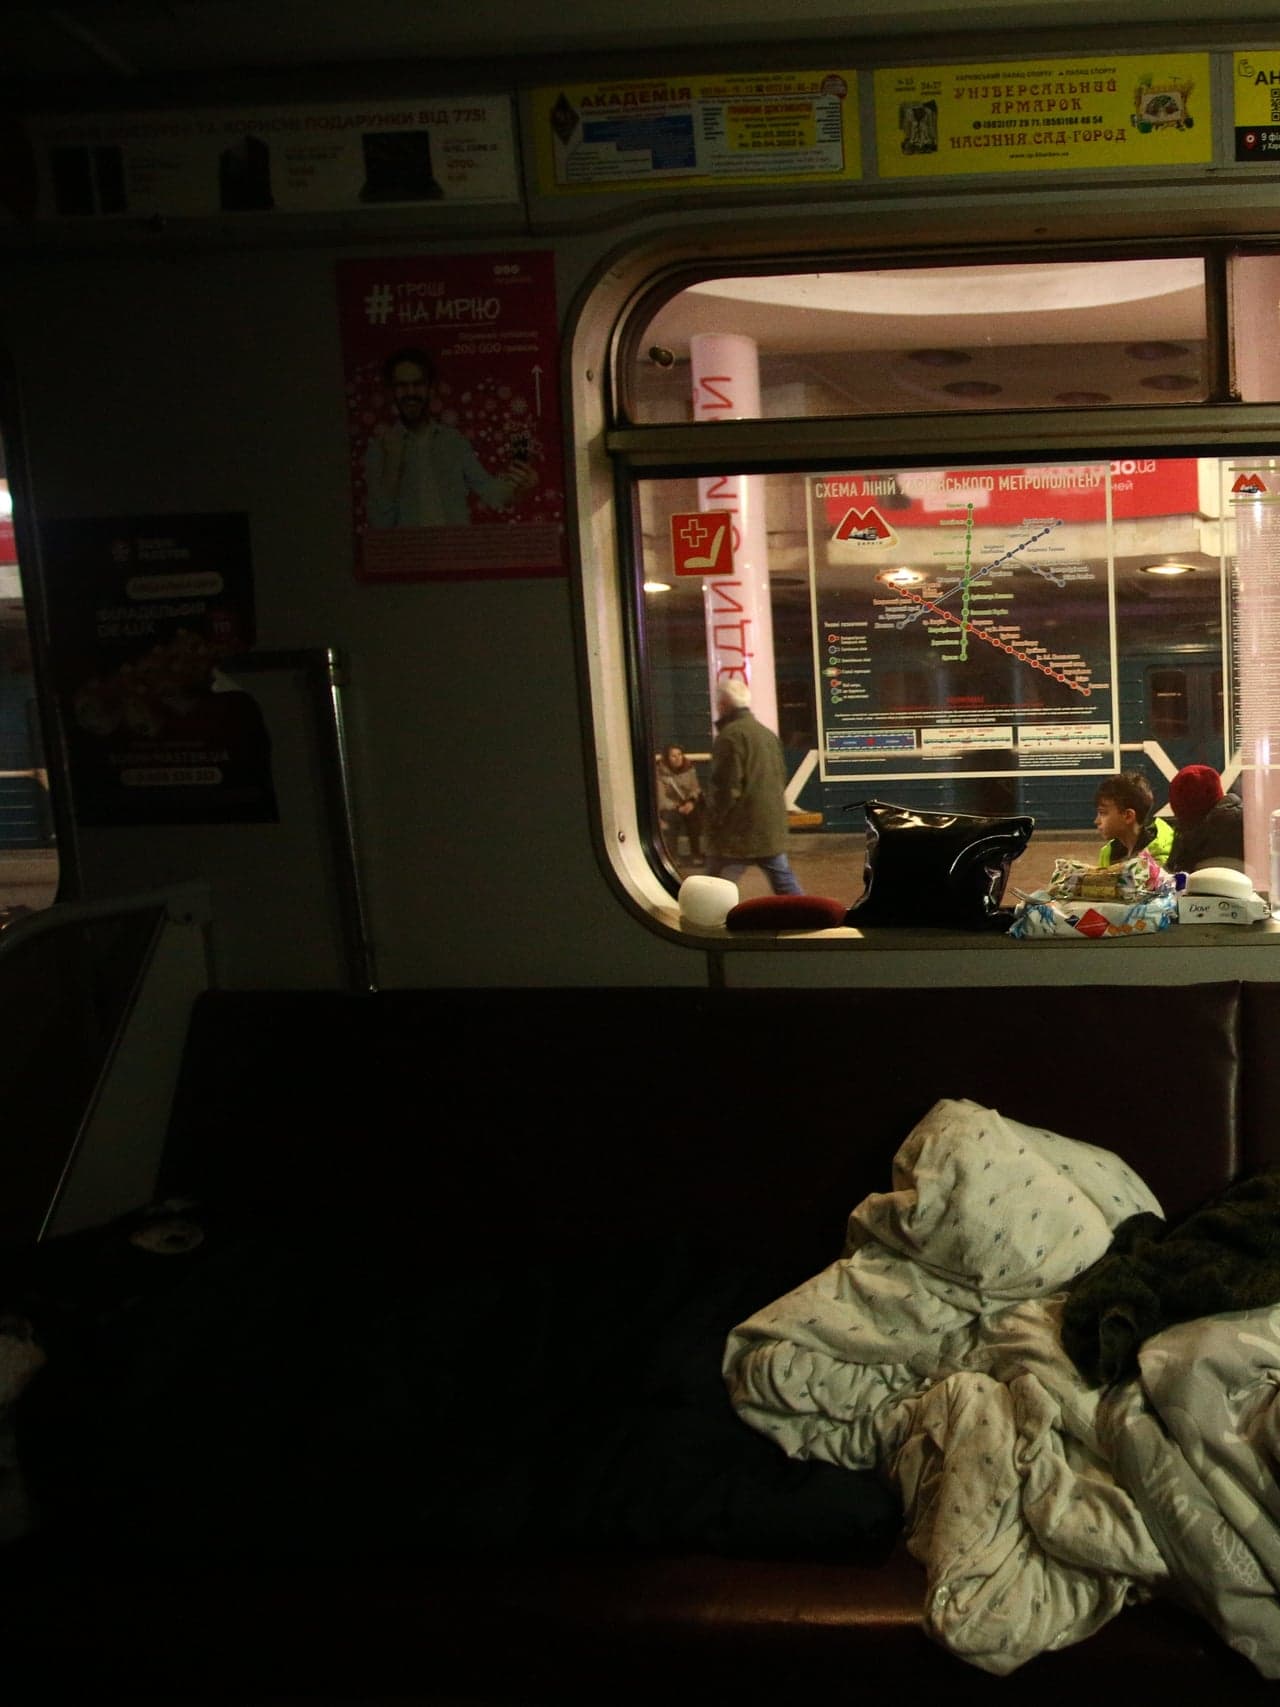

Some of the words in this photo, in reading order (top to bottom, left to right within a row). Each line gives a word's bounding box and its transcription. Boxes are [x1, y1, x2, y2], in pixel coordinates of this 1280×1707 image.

[581, 87, 692, 107] АКАДЕМІЯ
[991, 97, 1082, 115] ЯРМАРОК
[303, 112, 413, 132] ПОДАРУНКИ
[417, 109, 449, 127] ВІД
[950, 133, 1028, 151] НАСІННЯ
[400, 302, 430, 322] НА
[436, 297, 502, 321] МРІЮ
[815, 482, 858, 498] СХЕМА
[861, 476, 897, 497] ЛІНІЙ
[999, 472, 1102, 491] МЕТРОПОЛІТЕНУ
[1188, 902, 1211, 914] Dove
